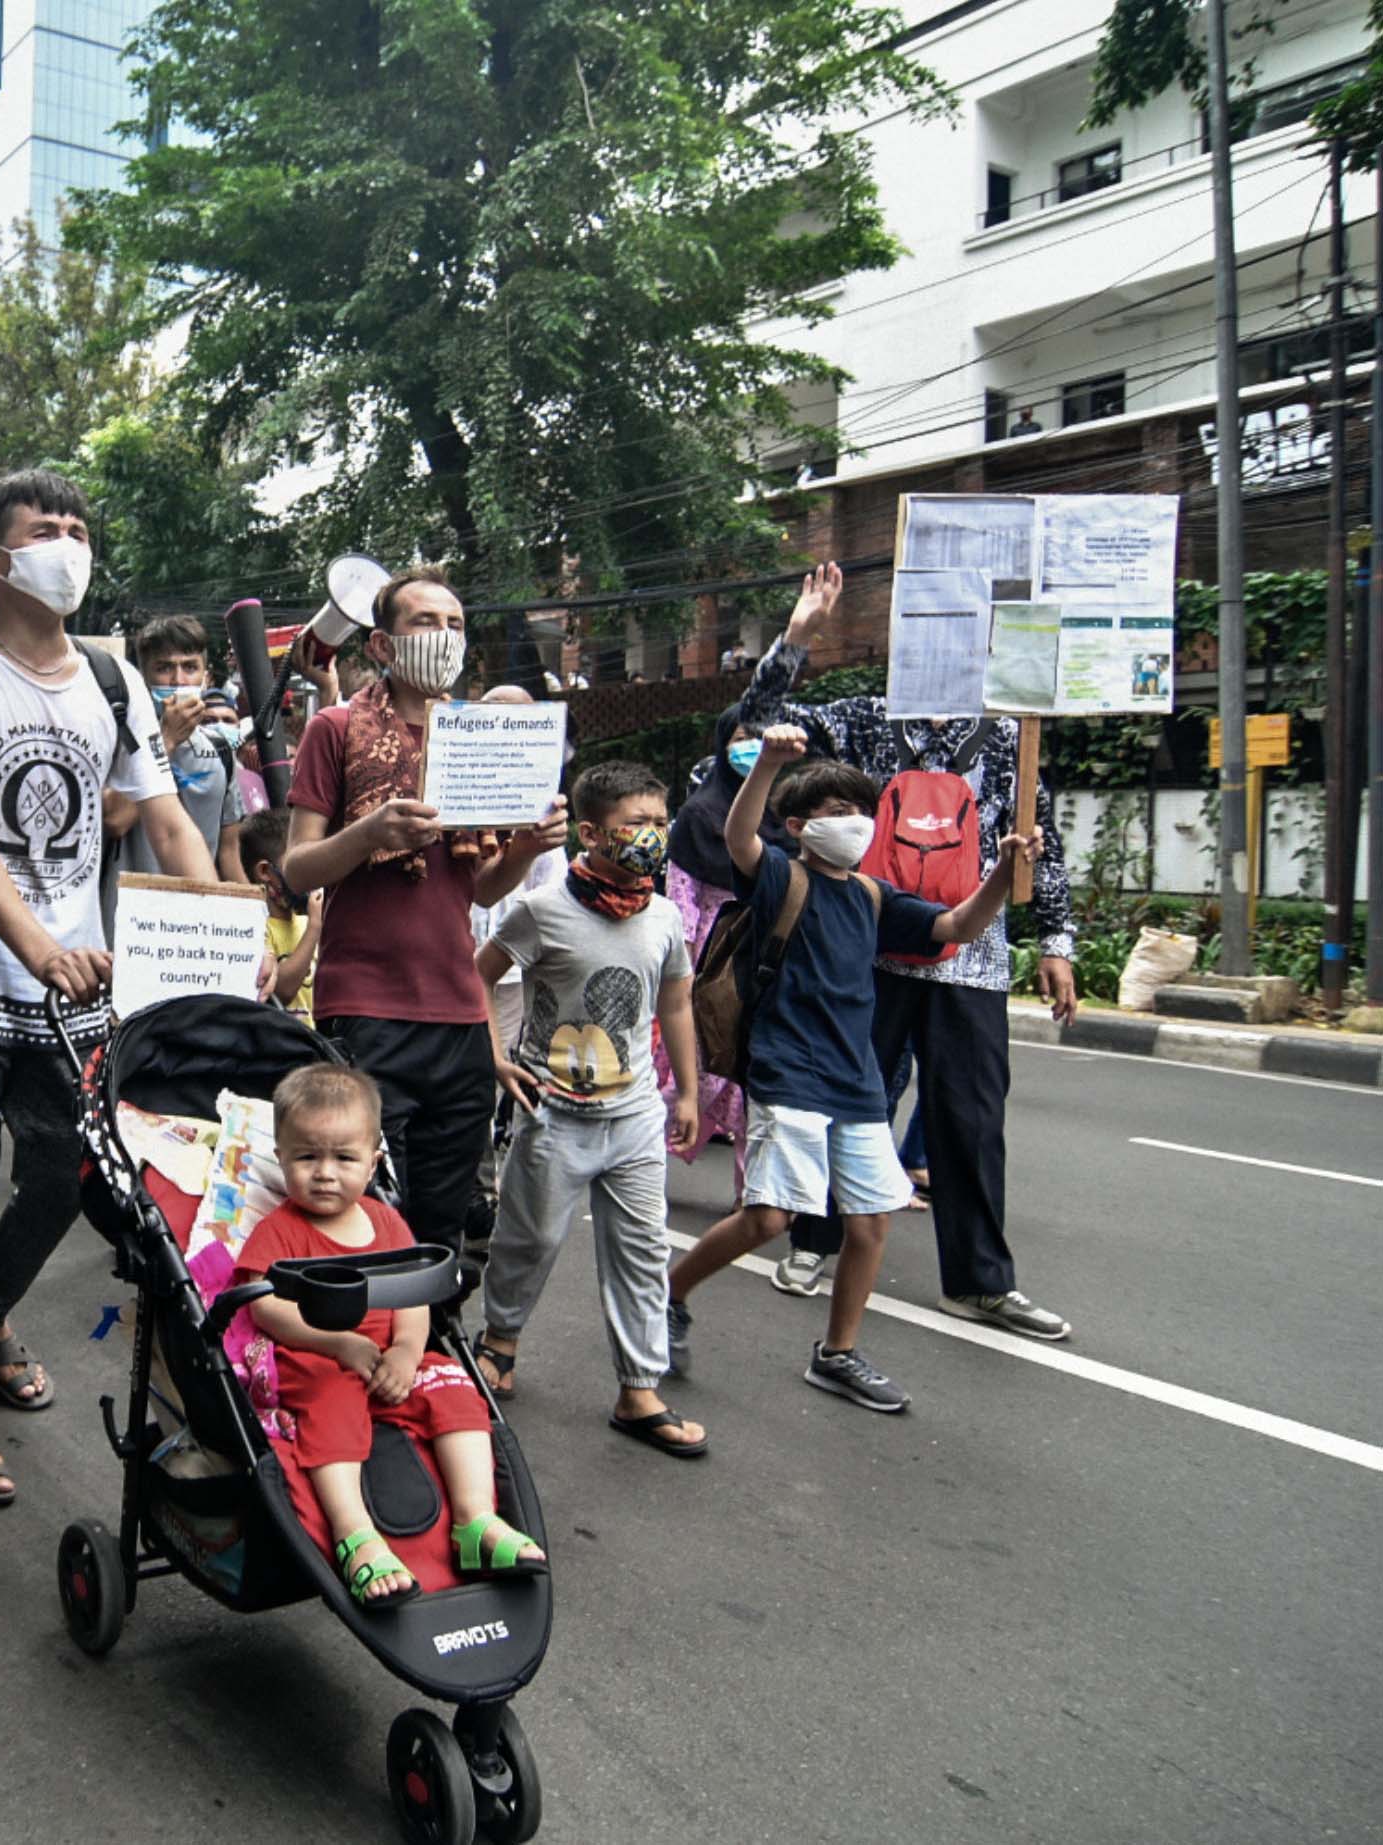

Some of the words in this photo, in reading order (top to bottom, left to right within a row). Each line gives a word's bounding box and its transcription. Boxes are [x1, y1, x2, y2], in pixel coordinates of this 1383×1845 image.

[437, 716, 500, 733] Refugees'
[502, 716, 558, 731] demands:
[159, 917, 208, 936] haven't
[211, 922, 254, 940] invited
[126, 944, 155, 958] you,
[157, 947, 175, 961] go
[177, 945, 206, 961] back
[209, 948, 225, 961] to
[226, 952, 255, 965] your
[432, 1625, 488, 1655] BRAVO
